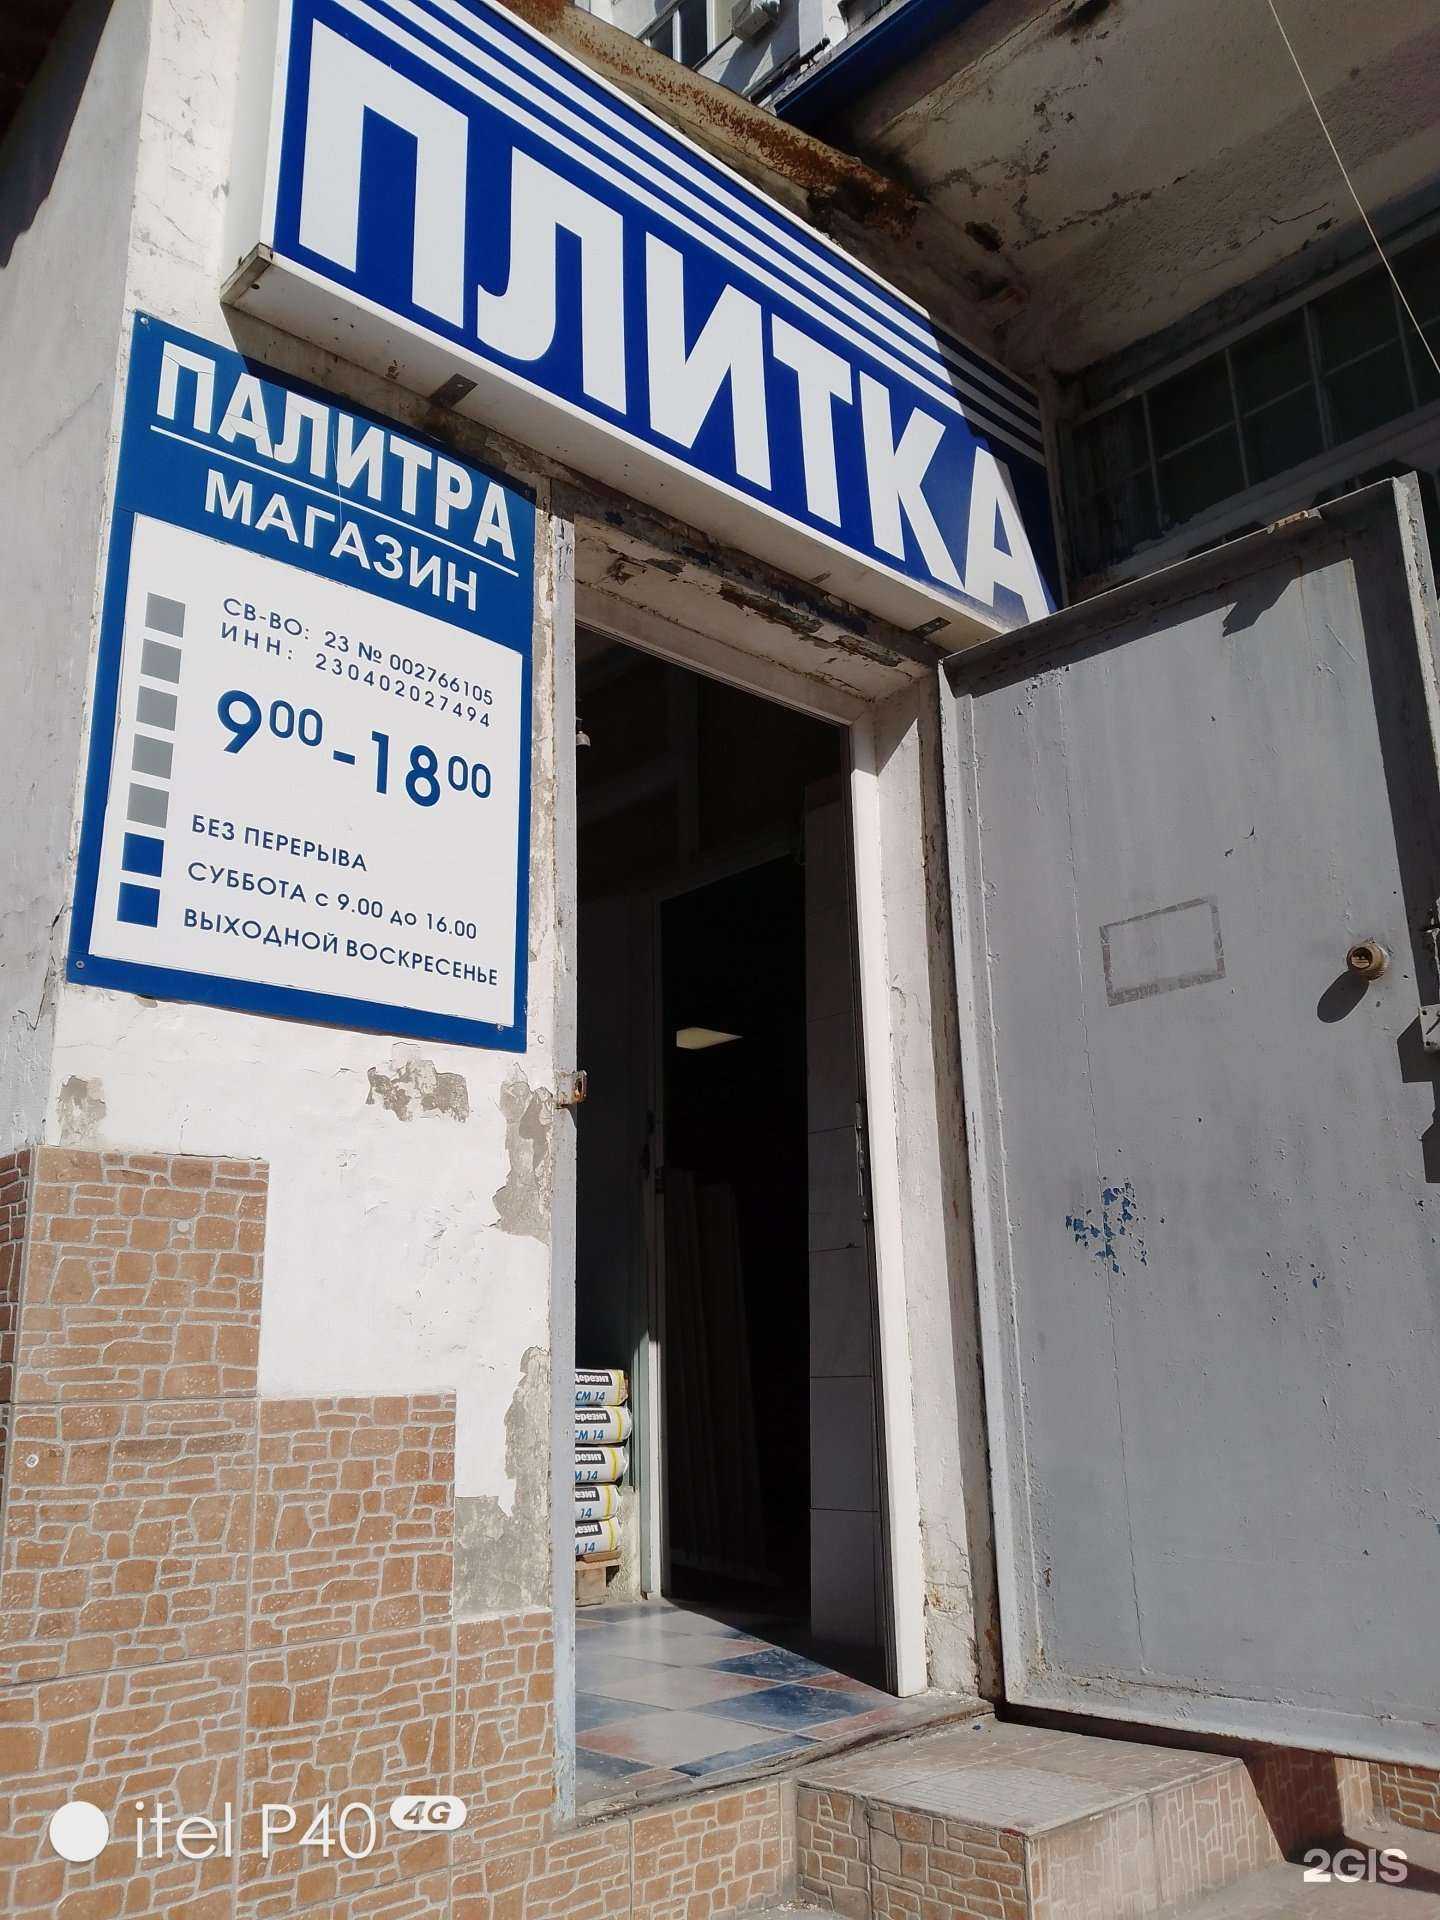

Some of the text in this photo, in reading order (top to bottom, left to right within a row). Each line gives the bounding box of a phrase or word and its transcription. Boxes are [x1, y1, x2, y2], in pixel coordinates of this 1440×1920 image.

[299, 18, 1052, 625] ПЛИТКА
[156, 340, 516, 561] ПАЛИТРА
[205, 468, 478, 612] МАГАЗИН
[221, 622, 490, 728] ИНН: 230402027494
[223, 597, 494, 706] СВ-ВО: 23 № 002766105
[192, 814, 367, 872] БЕЗ ПЕРЕРЫВА
[187, 862, 477, 940] СУББОТА с 9.00 до 16.00
[183, 908, 498, 986] ВЫХОДНОЙ ВОСКРЕСЕНЬЕ
[595, 1391, 605, 1401] 14
[593, 1430, 604, 1441] 14
[581, 1508, 592, 1518] 14
[587, 1471, 598, 1480] 14
[585, 1542, 595, 1553] 14
